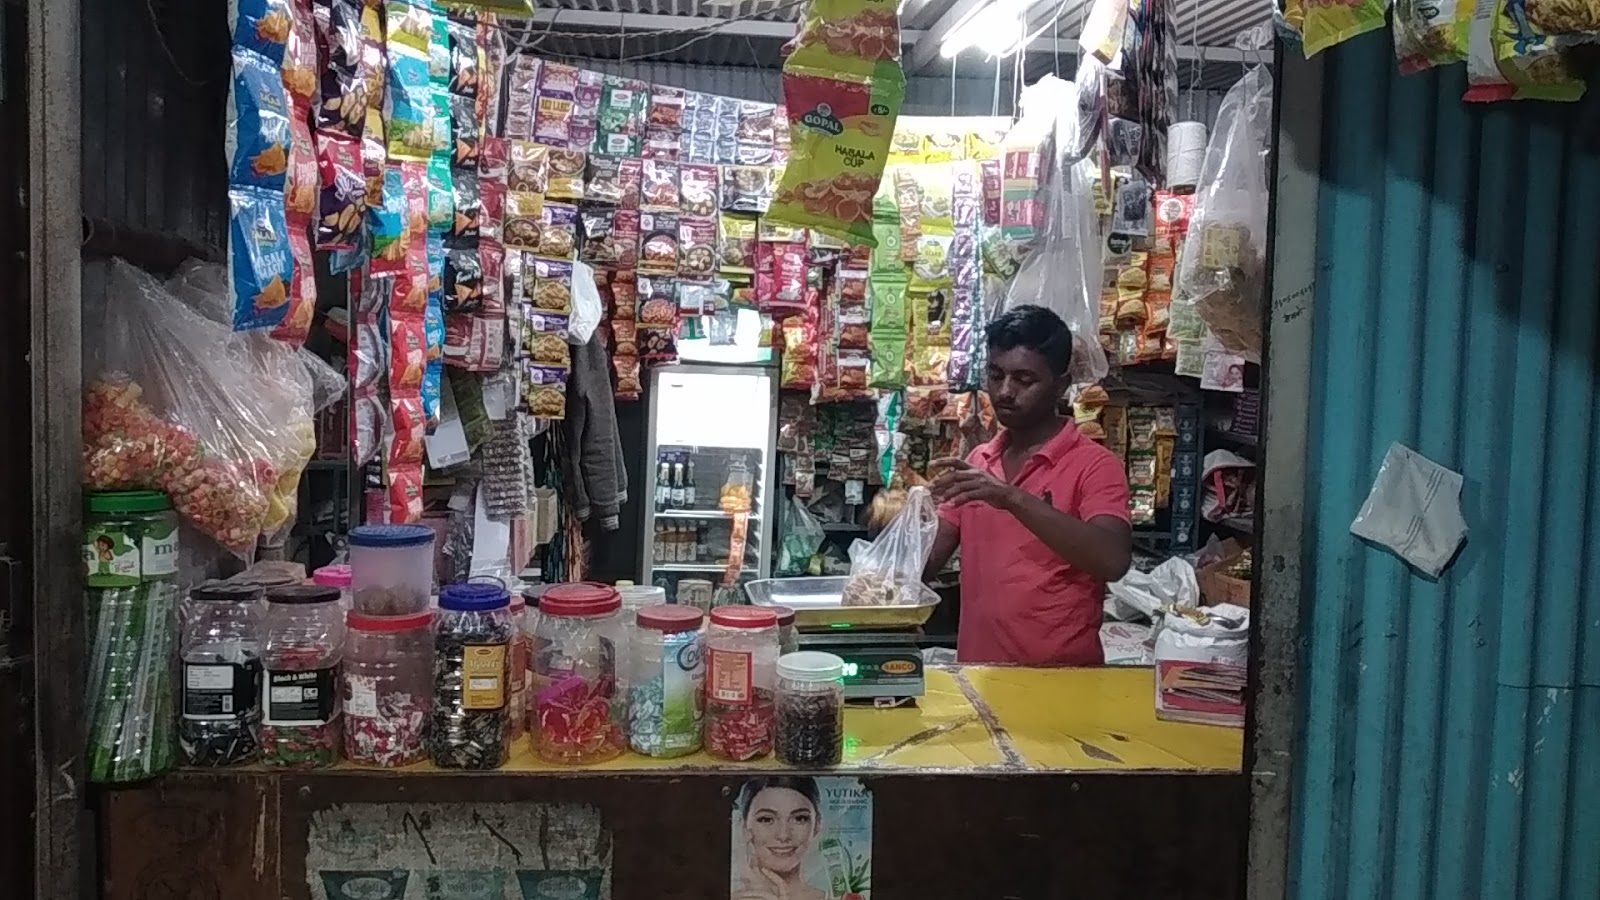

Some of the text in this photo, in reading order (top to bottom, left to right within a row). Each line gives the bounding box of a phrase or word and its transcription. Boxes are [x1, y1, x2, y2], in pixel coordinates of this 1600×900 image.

[804, 114, 841, 133] GOPAL
[843, 157, 865, 168] CUP
[273, 673, 291, 683] Black
[298, 672, 317, 680] White
